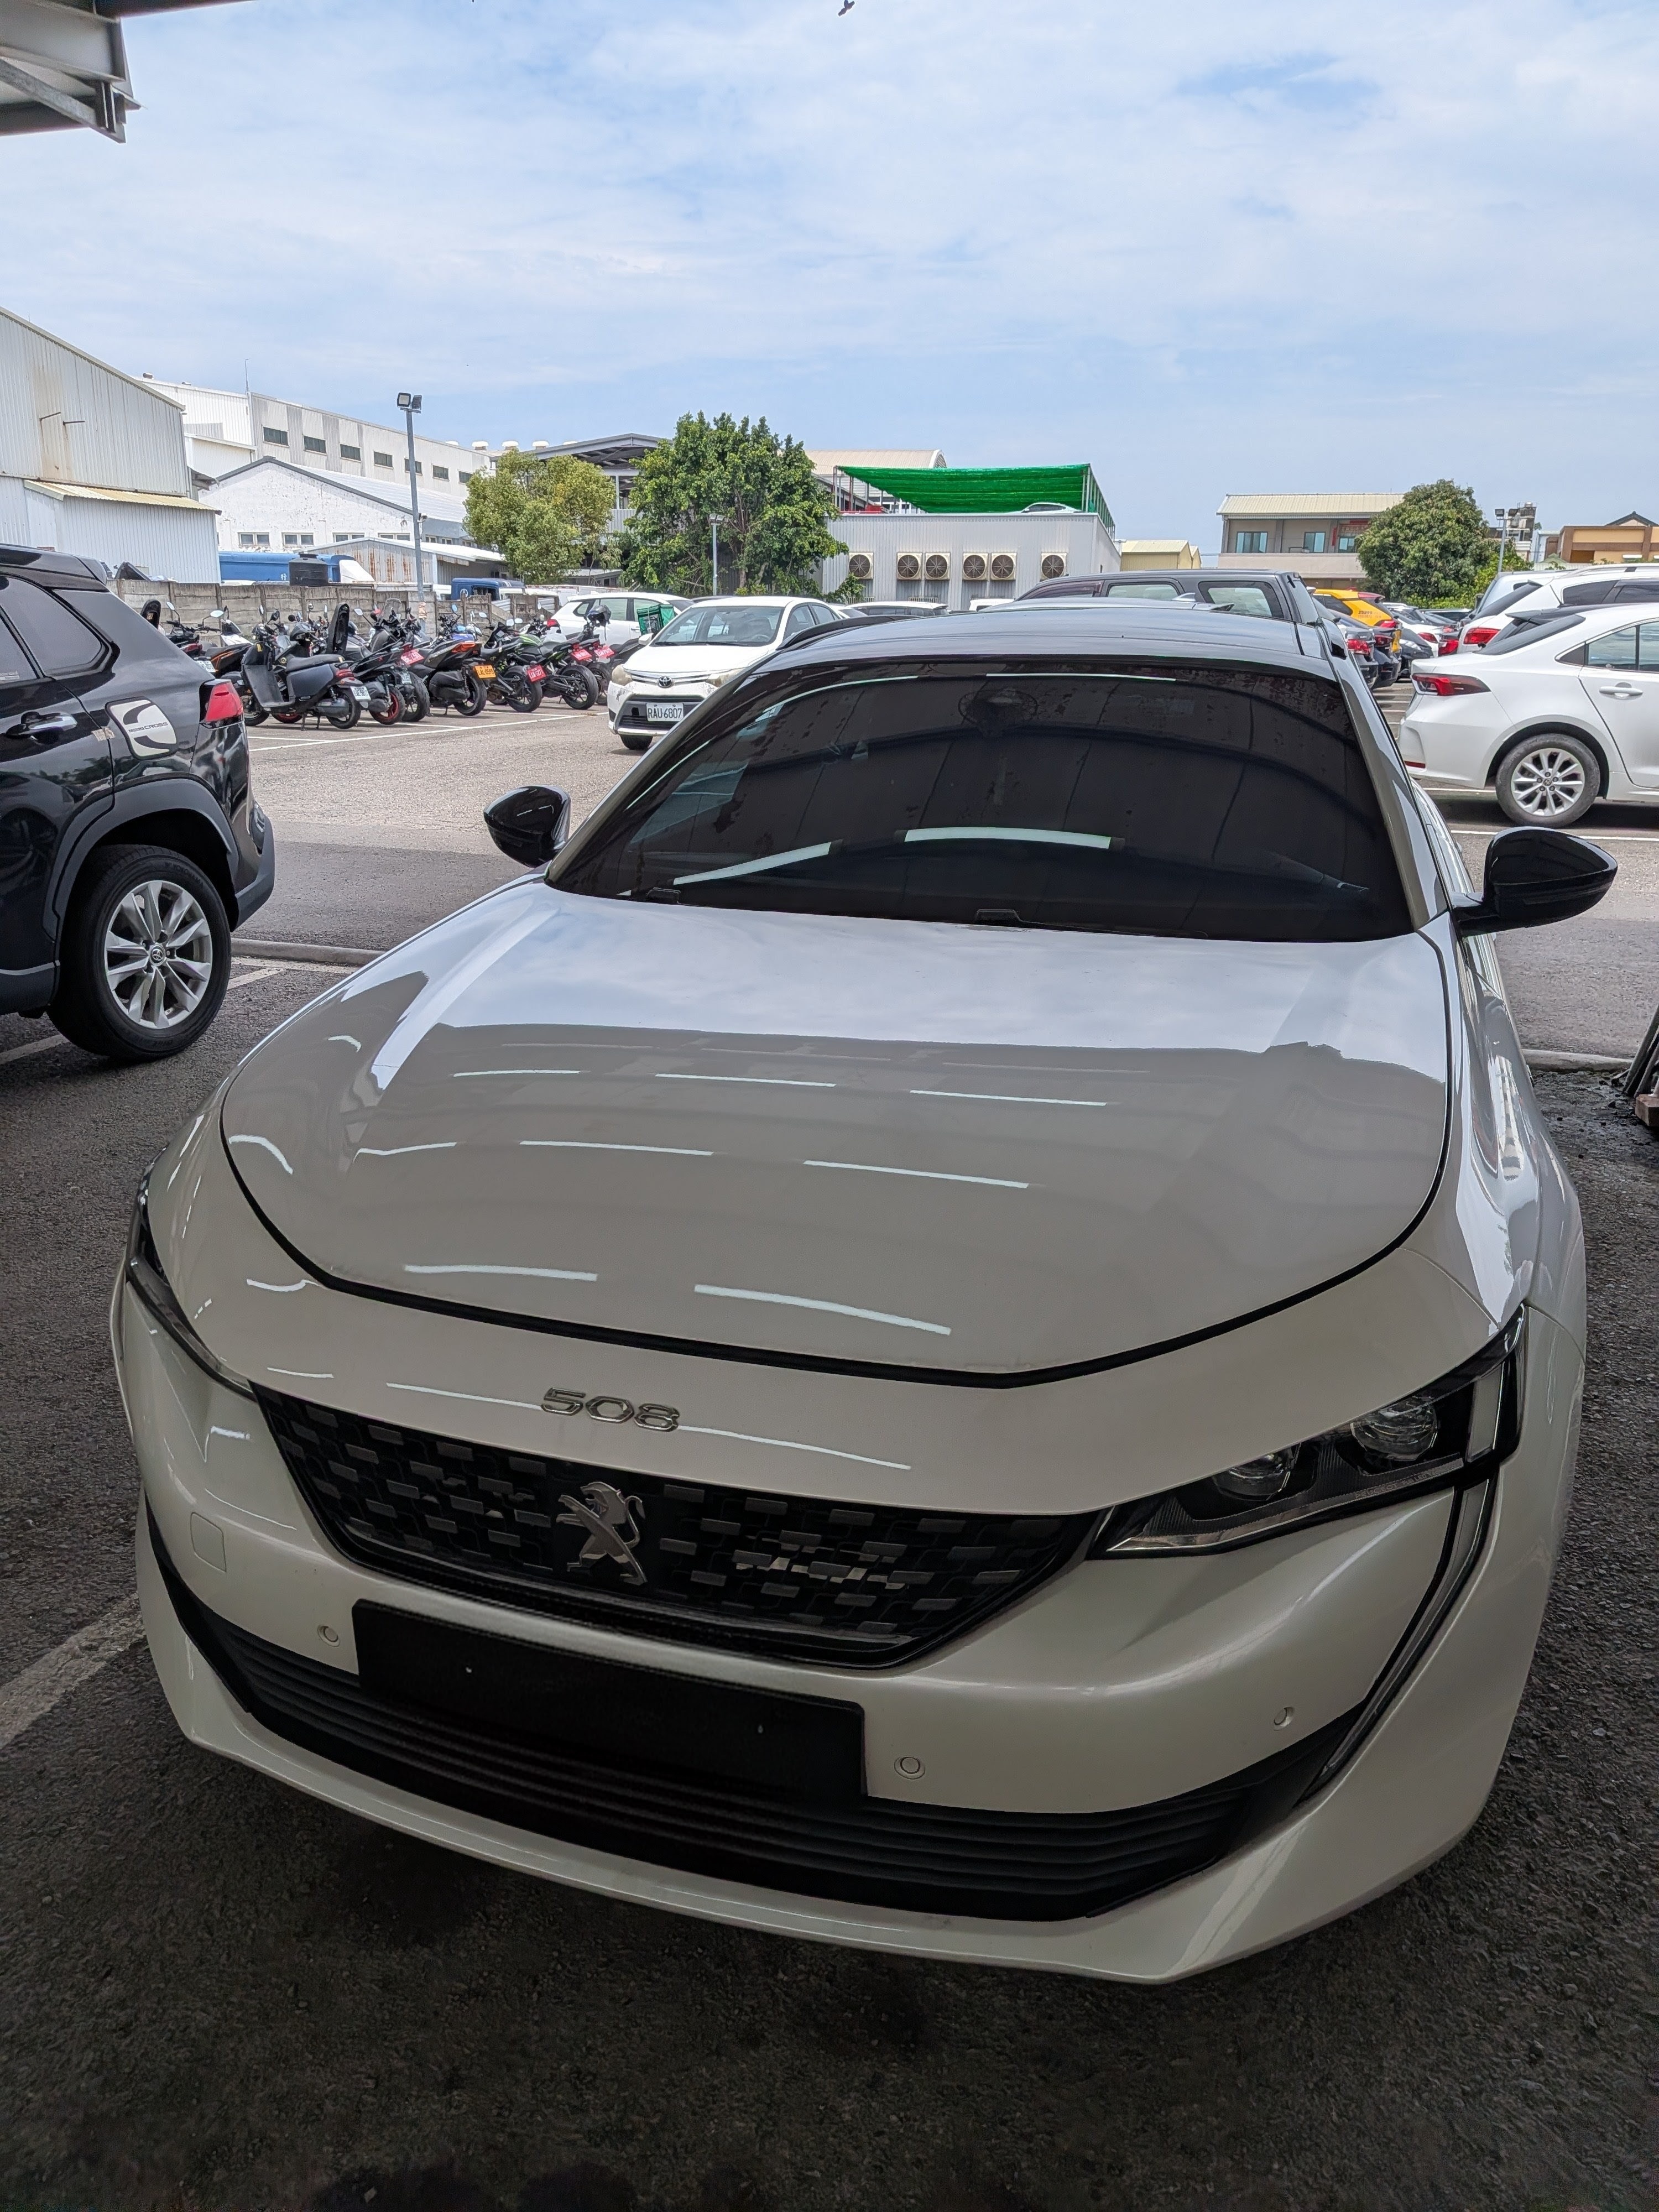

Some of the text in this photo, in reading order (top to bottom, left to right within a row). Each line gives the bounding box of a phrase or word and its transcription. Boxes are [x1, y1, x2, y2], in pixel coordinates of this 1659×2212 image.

[648, 708, 682, 718] RAU-6807
[540, 1387, 680, 1432] 508
[1355, 1483, 1398, 1499] PEUGEOT
